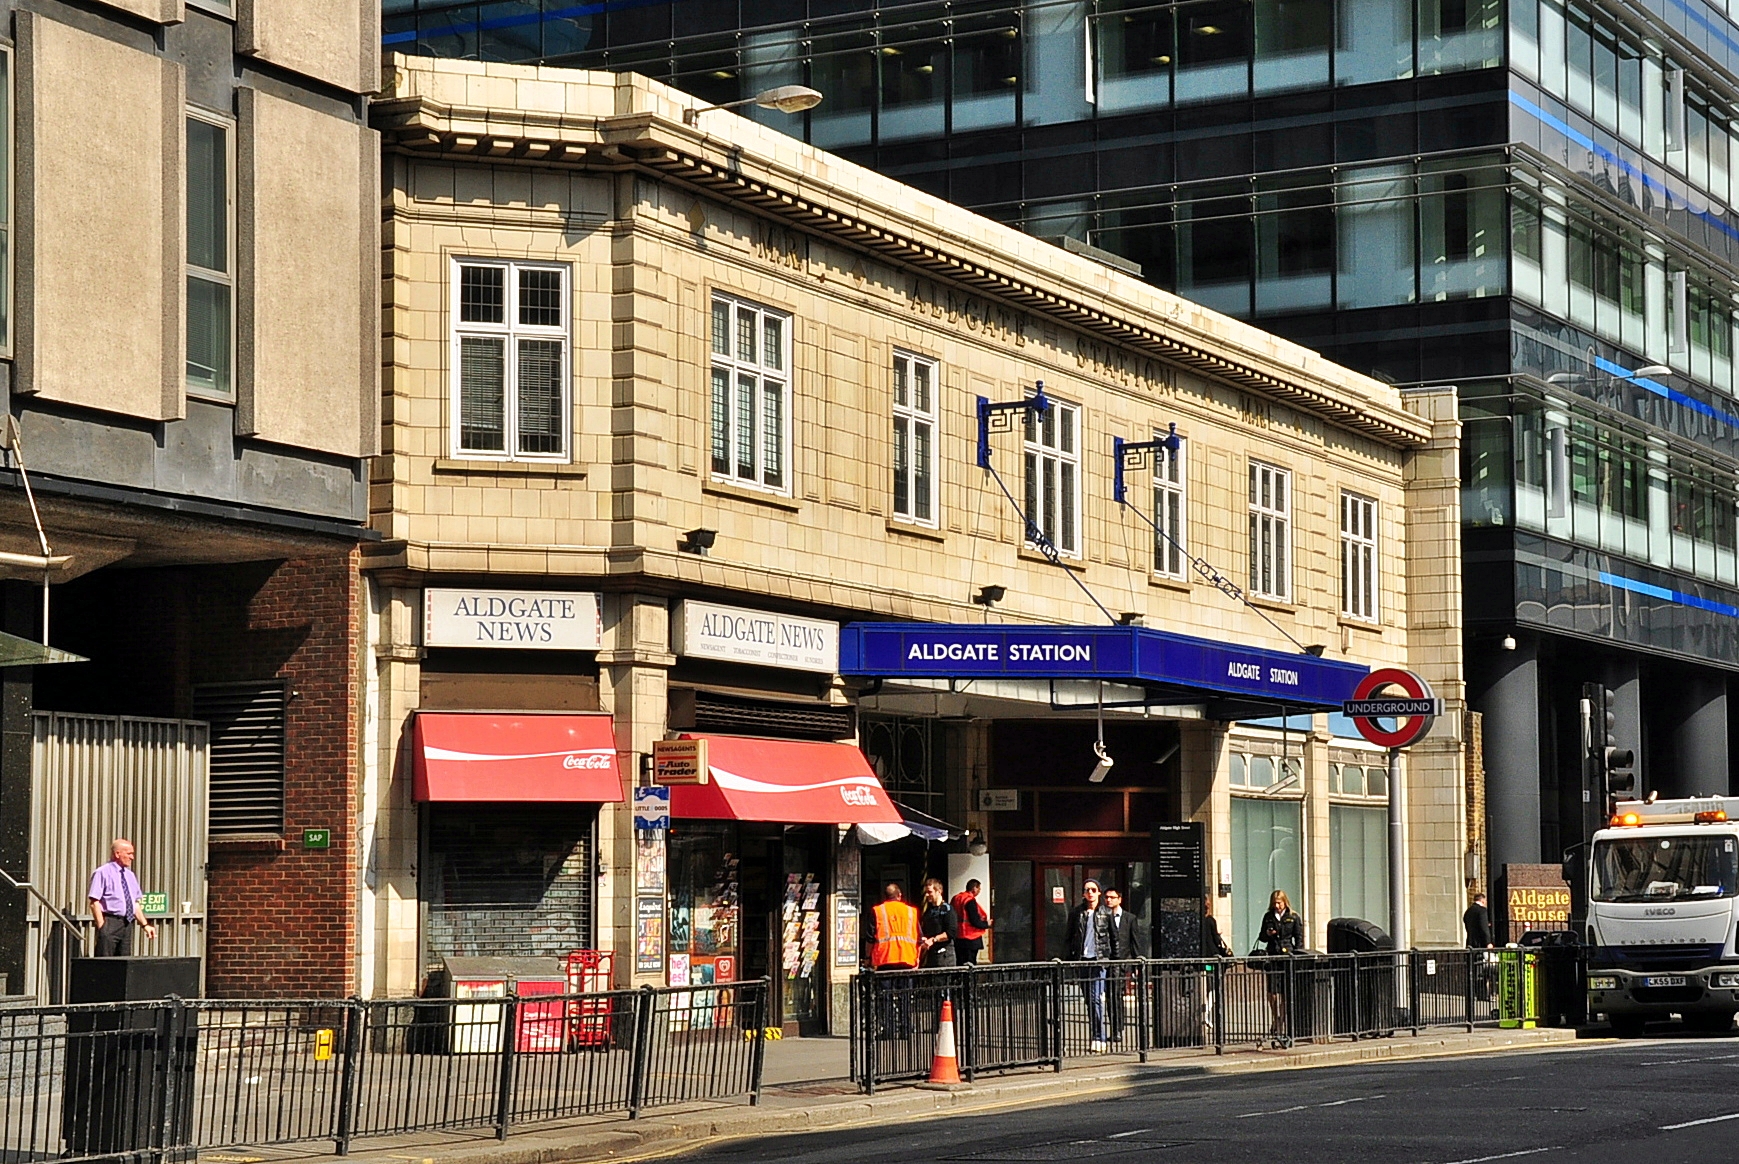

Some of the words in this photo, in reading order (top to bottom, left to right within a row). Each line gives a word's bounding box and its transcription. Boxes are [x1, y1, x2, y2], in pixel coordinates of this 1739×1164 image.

[910, 279, 1026, 348] ALDGATE
[1075, 337, 1172, 396] STATION
[453, 597, 576, 619] ALDGATE
[476, 621, 552, 642] NEWS
[700, 612, 776, 644] ALDGATE
[780, 623, 824, 651] NEWS
[908, 643, 999, 660] ALDGATE
[1009, 644, 1091, 661] STATION
[1227, 661, 1261, 681] ALDGATE
[1269, 667, 1299, 686] STATION
[1346, 702, 1431, 714] UNDERGROUND
[657, 745, 697, 753] NEWSAGENTS
[665, 760, 690, 768] Auto
[657, 768, 697, 776] Trader
[148, 894, 166, 904] EXIT
[1509, 889, 1570, 909] Aldgate
[145, 904, 165, 912] CLEAR
[1513, 906, 1566, 922] House
[1644, 907, 1676, 916] IVECO
[1620, 937, 1707, 945] EUROCARGO
[1670, 976, 1685, 985] DXF
